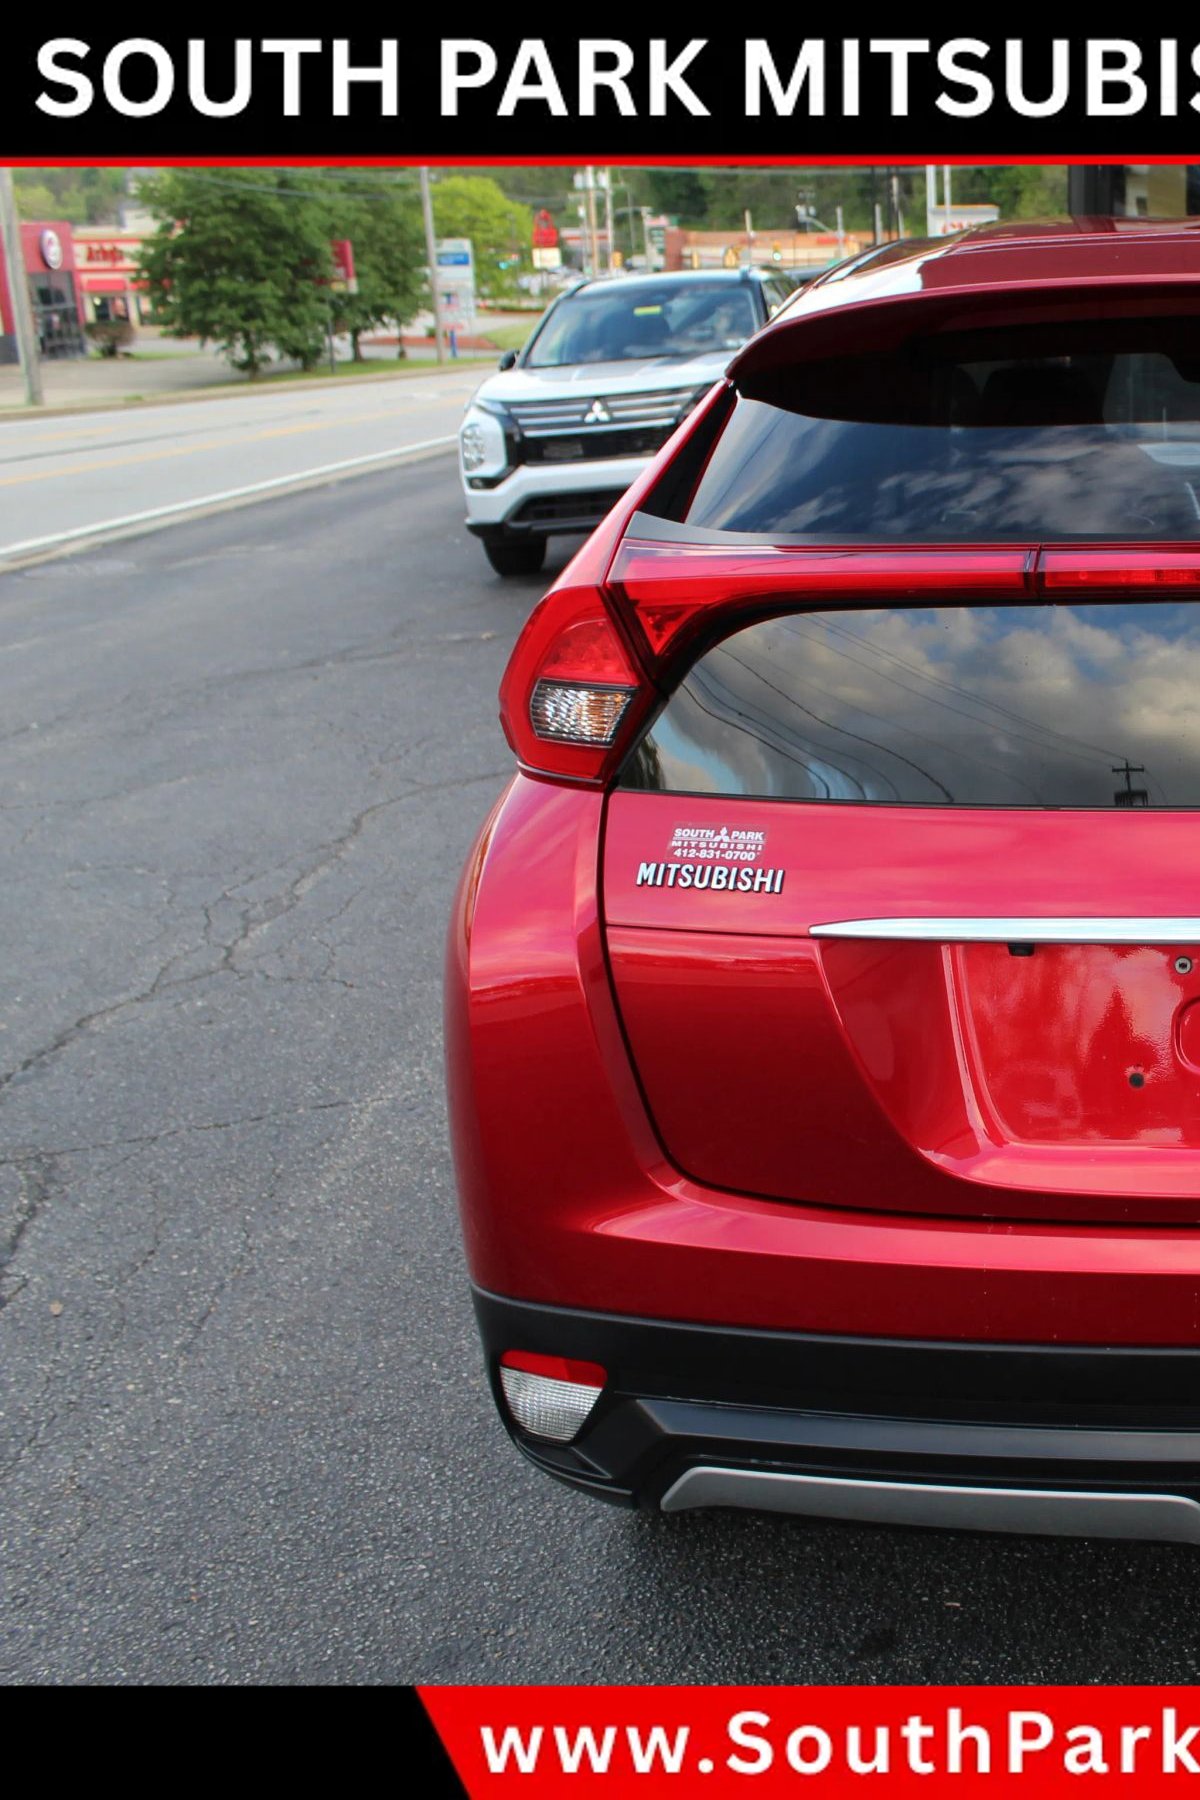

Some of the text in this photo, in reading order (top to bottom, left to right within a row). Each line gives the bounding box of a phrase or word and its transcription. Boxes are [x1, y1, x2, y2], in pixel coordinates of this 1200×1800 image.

[673, 827, 765, 841] SOUTH PARK
[671, 840, 763, 851] MITSUBISHI
[673, 848, 756, 861] 412-831-0700
[636, 862, 785, 894] MITSUBISHI
